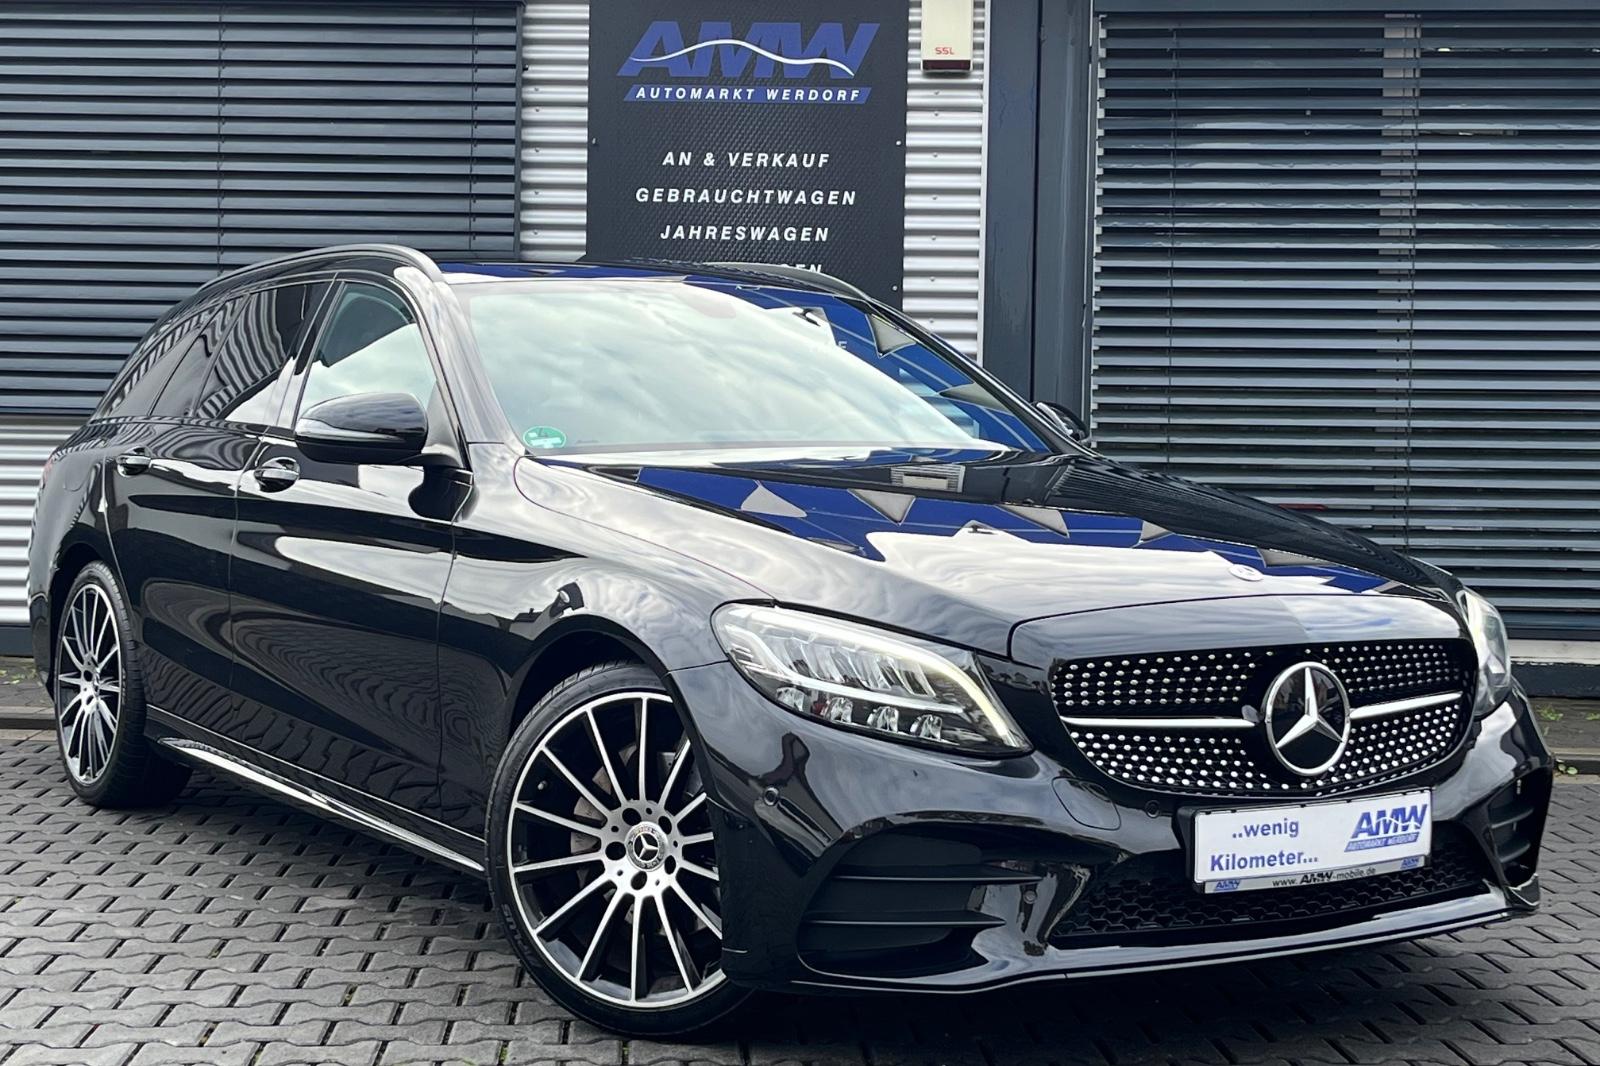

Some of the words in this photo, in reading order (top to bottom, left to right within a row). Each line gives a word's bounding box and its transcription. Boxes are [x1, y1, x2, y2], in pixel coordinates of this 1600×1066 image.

[616, 21, 880, 78] AMW
[935, 46, 955, 55] SSL
[635, 87, 755, 99] AUTOMARKT
[766, 88, 860, 101] WERDORF
[662, 151, 692, 166] AN
[703, 152, 715, 167] &
[728, 152, 829, 168] VERKAUF
[635, 187, 856, 205] GEBRAUCHTWAGEN
[660, 224, 829, 242] JAHRESWAGEN
[1351, 803, 1428, 839] AMW
[1210, 850, 1318, 872] Kilometer...
